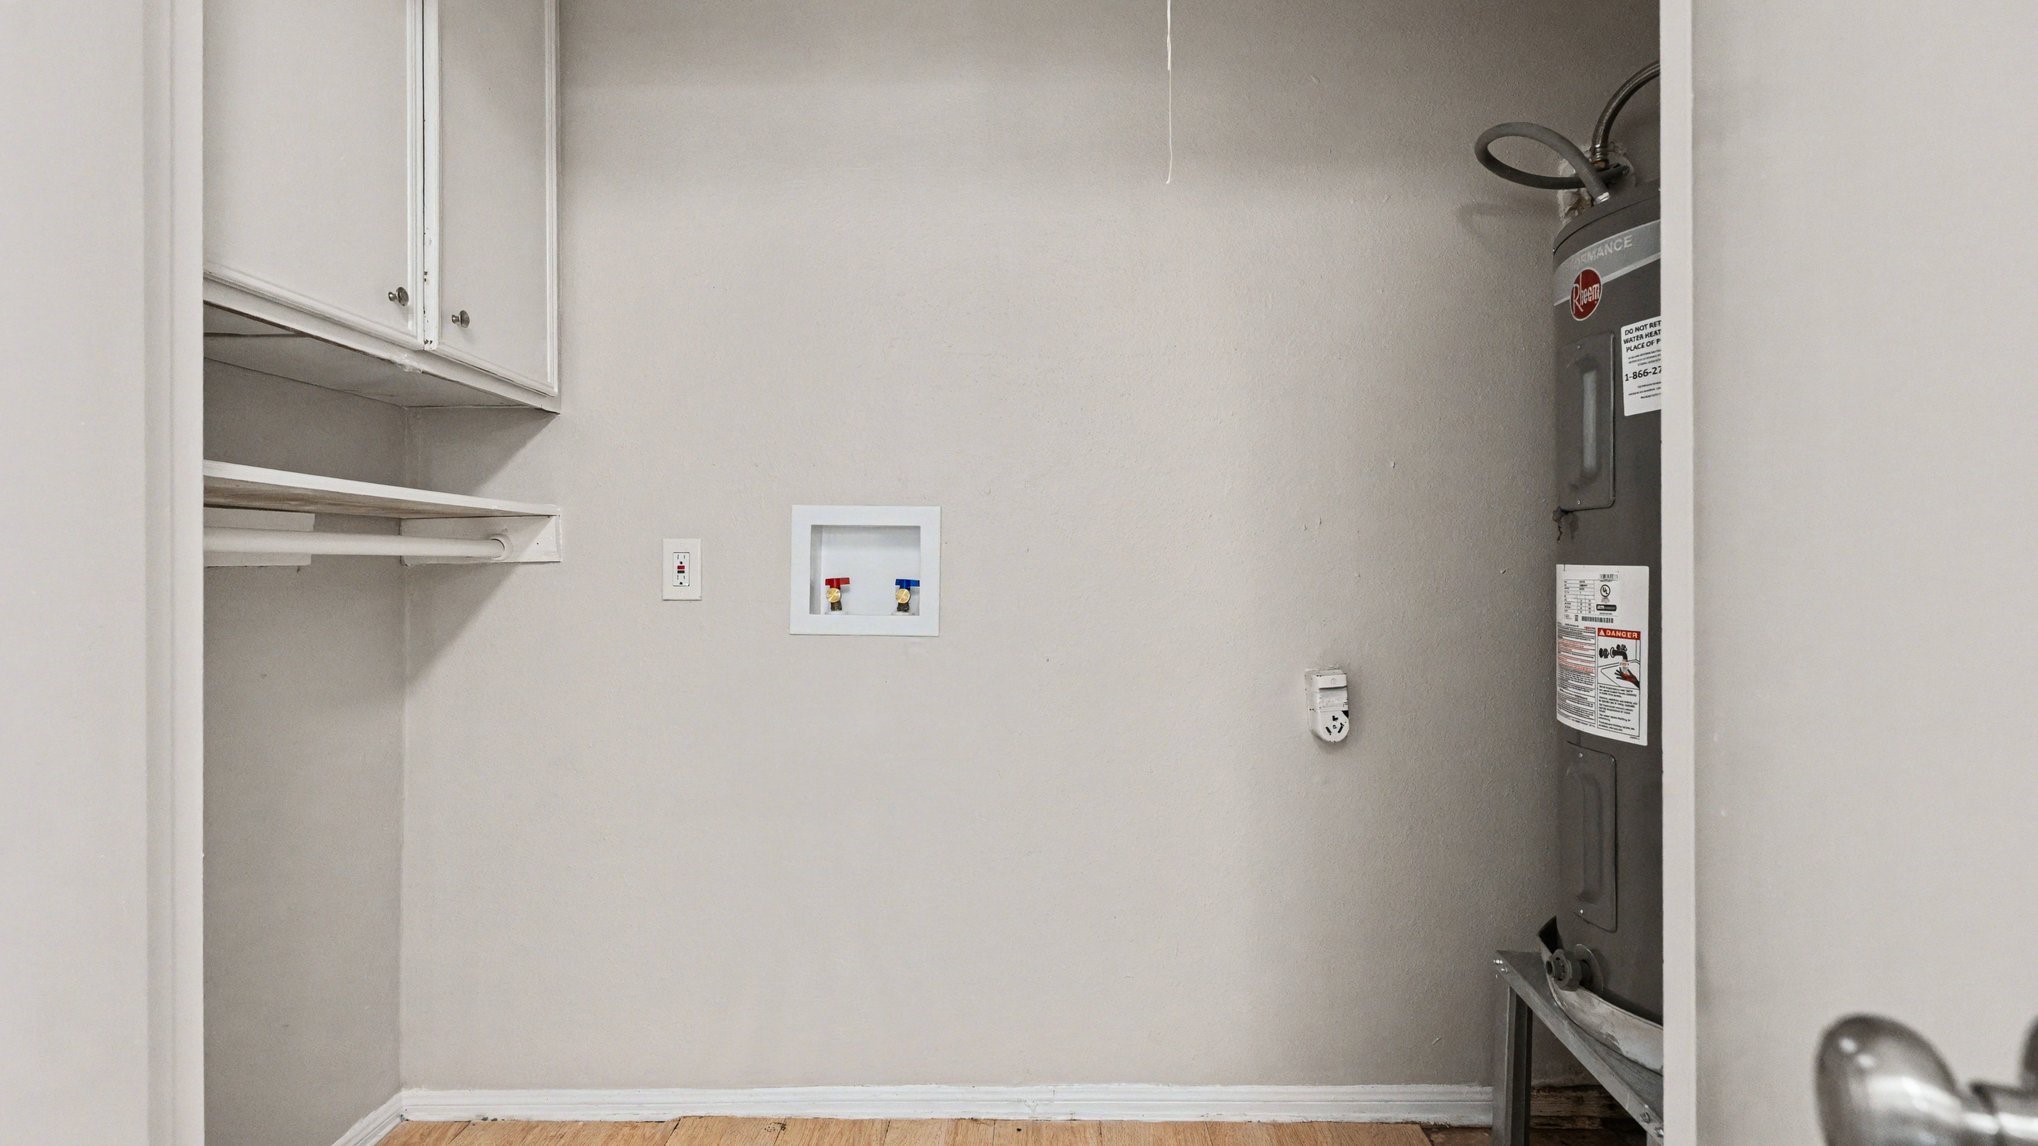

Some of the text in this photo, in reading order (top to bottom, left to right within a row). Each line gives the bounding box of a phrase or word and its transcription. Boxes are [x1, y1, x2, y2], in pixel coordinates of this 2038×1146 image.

[1572, 271, 1600, 314] Rheem
[1624, 328, 1634, 336] DO
[1634, 323, 1649, 333] NOT
[1623, 333, 1644, 344] WATER
[1625, 342, 1645, 353] PLACE
[1645, 339, 1656, 348] OF
[1605, 629, 1638, 639] DANGER
